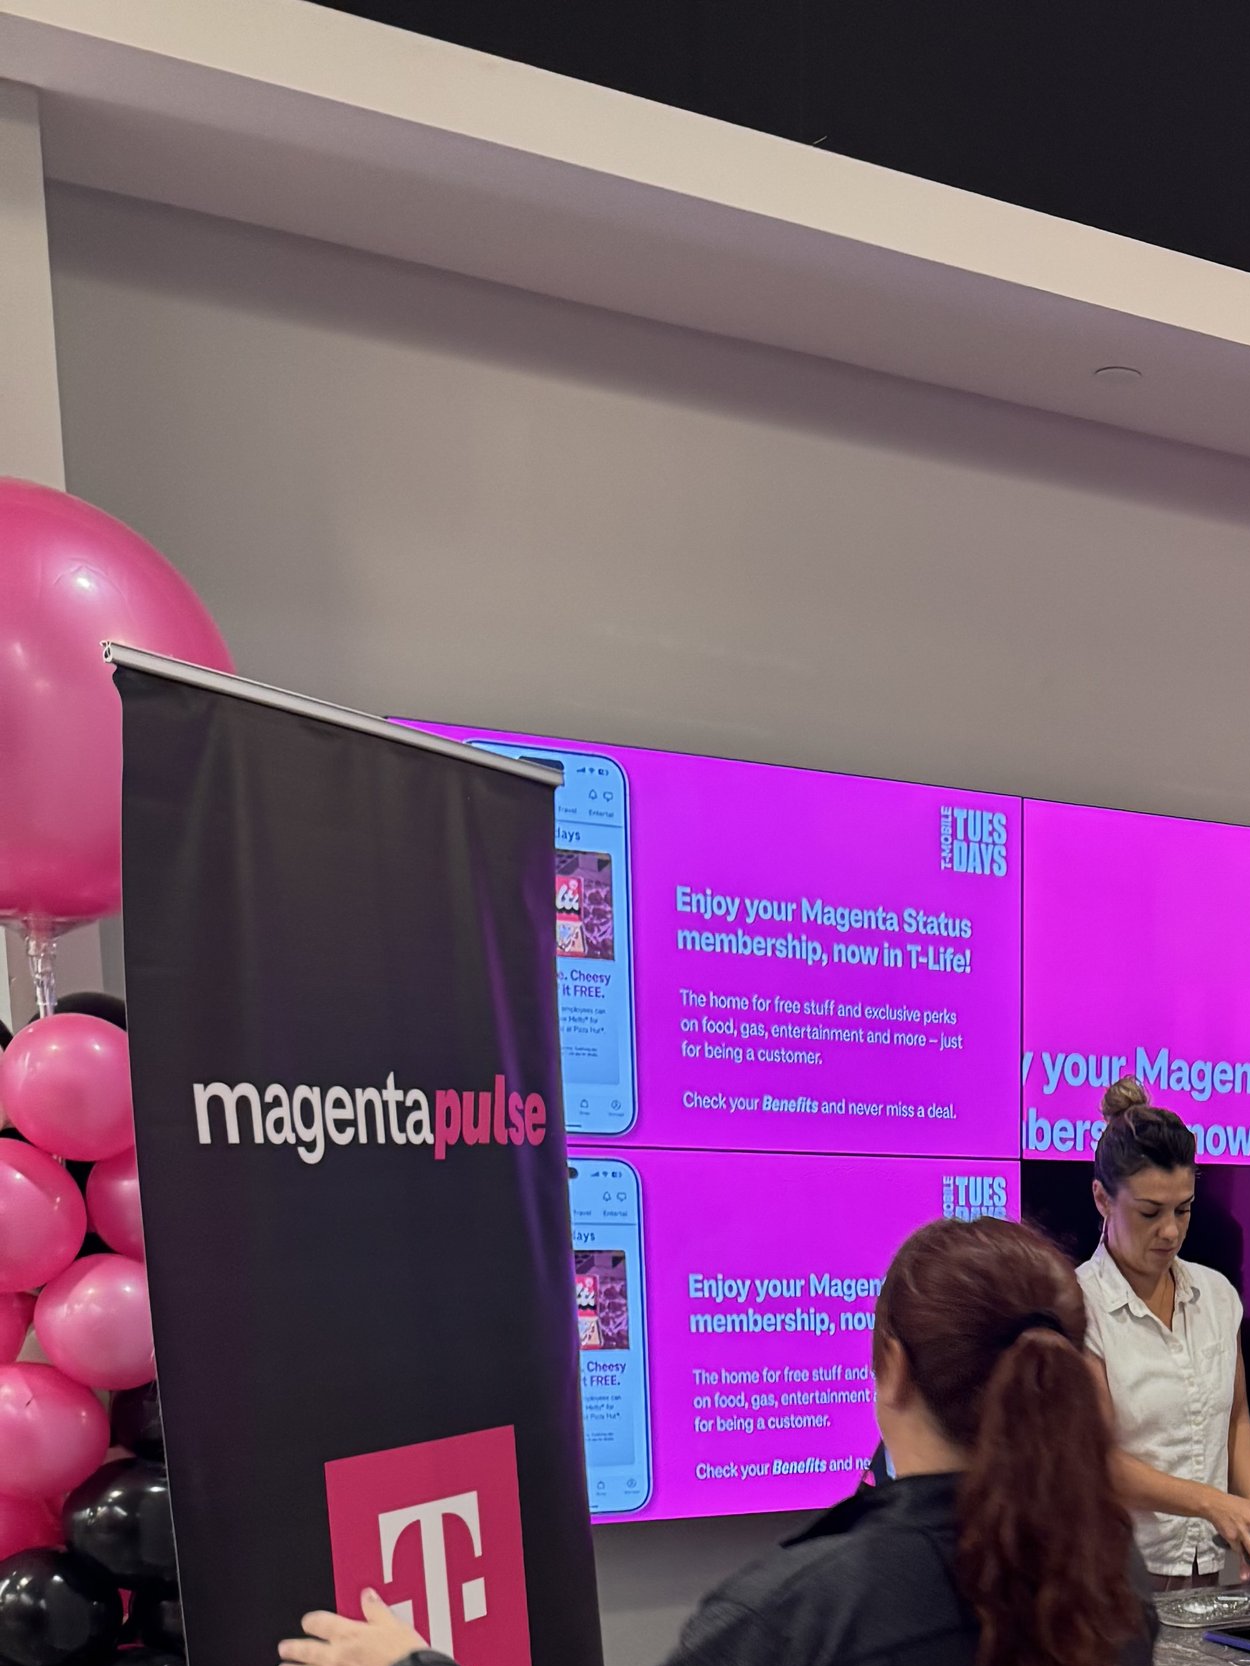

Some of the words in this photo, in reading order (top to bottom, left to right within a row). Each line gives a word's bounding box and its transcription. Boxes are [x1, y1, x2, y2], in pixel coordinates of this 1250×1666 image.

[953, 807, 1007, 845] TUES
[953, 839, 1007, 877] DAYS
[676, 885, 740, 922] Enjoy
[744, 897, 796, 924] your
[801, 897, 899, 932] Magenta
[902, 907, 972, 939] Status
[677, 928, 828, 967] membership,
[833, 942, 879, 966] now
[883, 941, 903, 968] in
[906, 944, 971, 974] T-Life!
[574, 985, 605, 999] FREE.
[680, 988, 706, 1008] The
[709, 991, 749, 1010] home
[752, 993, 771, 1011] for
[774, 995, 801, 1014] free
[803, 999, 835, 1016] stuff
[837, 1002, 862, 1018] and
[864, 1003, 921, 1022] exclusive
[923, 1008, 957, 1026] perks
[680, 1018, 698, 1032] on
[702, 1016, 738, 1037] food,
[740, 1022, 769, 1039] gas,
[771, 1021, 864, 1043] entertainment
[866, 1028, 891, 1044] and
[893, 1031, 926, 1047] more
[939, 1031, 963, 1051] just
[681, 1040, 701, 1057] for
[704, 1041, 743, 1063] being
[746, 1048, 754, 1061] a
[757, 1048, 822, 1064] customer.
[1041, 1051, 1127, 1095] your
[193, 1071, 547, 1165] magentapulse
[682, 1091, 726, 1109] Check
[728, 1096, 759, 1113] your
[762, 1094, 818, 1113] Benefits
[821, 1098, 846, 1114] and
[848, 1102, 884, 1116] never
[886, 1101, 915, 1118] miss
[917, 1106, 925, 1118] a
[927, 1103, 957, 1119] deal.
[955, 1175, 1007, 1206] TUES
[688, 1273, 750, 1303] Enjoy
[754, 1279, 805, 1303] your
[690, 1307, 835, 1336] membership,
[590, 1374, 621, 1387] FREE.
[692, 1367, 718, 1385] The
[721, 1368, 759, 1385] home
[762, 1366, 781, 1383] for
[783, 1366, 809, 1382] free
[812, 1364, 842, 1382] stuff
[844, 1365, 868, 1381] and
[693, 1396, 711, 1409] on
[714, 1391, 749, 1411] food,
[751, 1394, 779, 1411] gas,
[781, 1387, 870, 1406] entertainment
[694, 1416, 713, 1432] for
[716, 1415, 753, 1434] being
[756, 1418, 765, 1430] a
[768, 1413, 831, 1429] customer.
[696, 1461, 738, 1480] Check
[740, 1463, 770, 1480] your
[772, 1457, 827, 1476] Benefits
[829, 1455, 853, 1471] and
